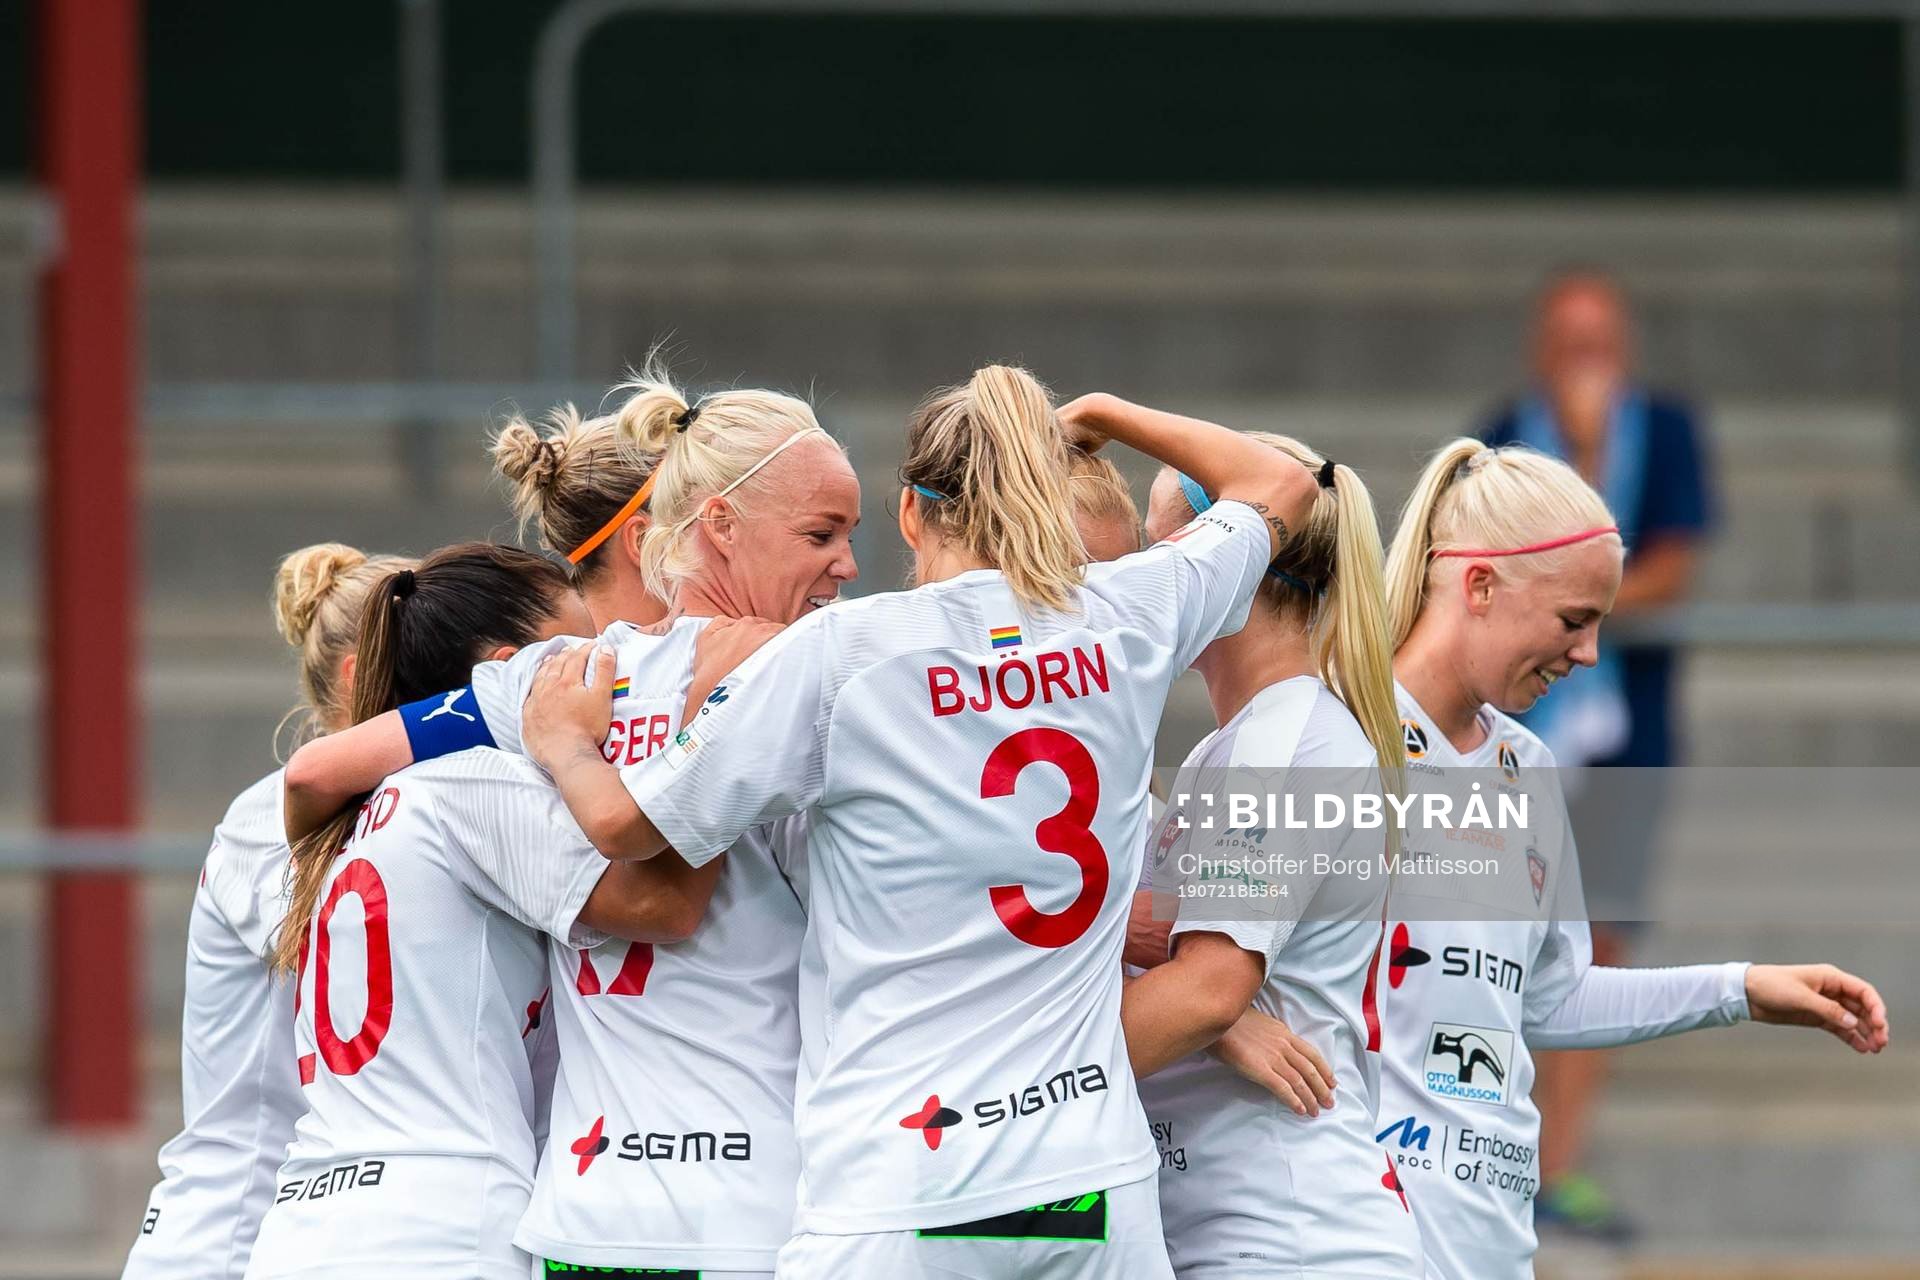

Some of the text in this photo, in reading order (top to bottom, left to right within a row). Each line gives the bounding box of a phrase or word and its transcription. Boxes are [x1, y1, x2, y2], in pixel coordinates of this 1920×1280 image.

[926, 642, 1111, 717] BJÖRN
[980, 726, 1110, 949] 3
[1215, 838, 1265, 858] MIDROC
[1426, 1071, 1456, 1085] OTTO
[1427, 1083, 1502, 1102] MAGNUSSON
[1458, 1129, 1536, 1170] Embassy
[1455, 1160, 1482, 1182] of
